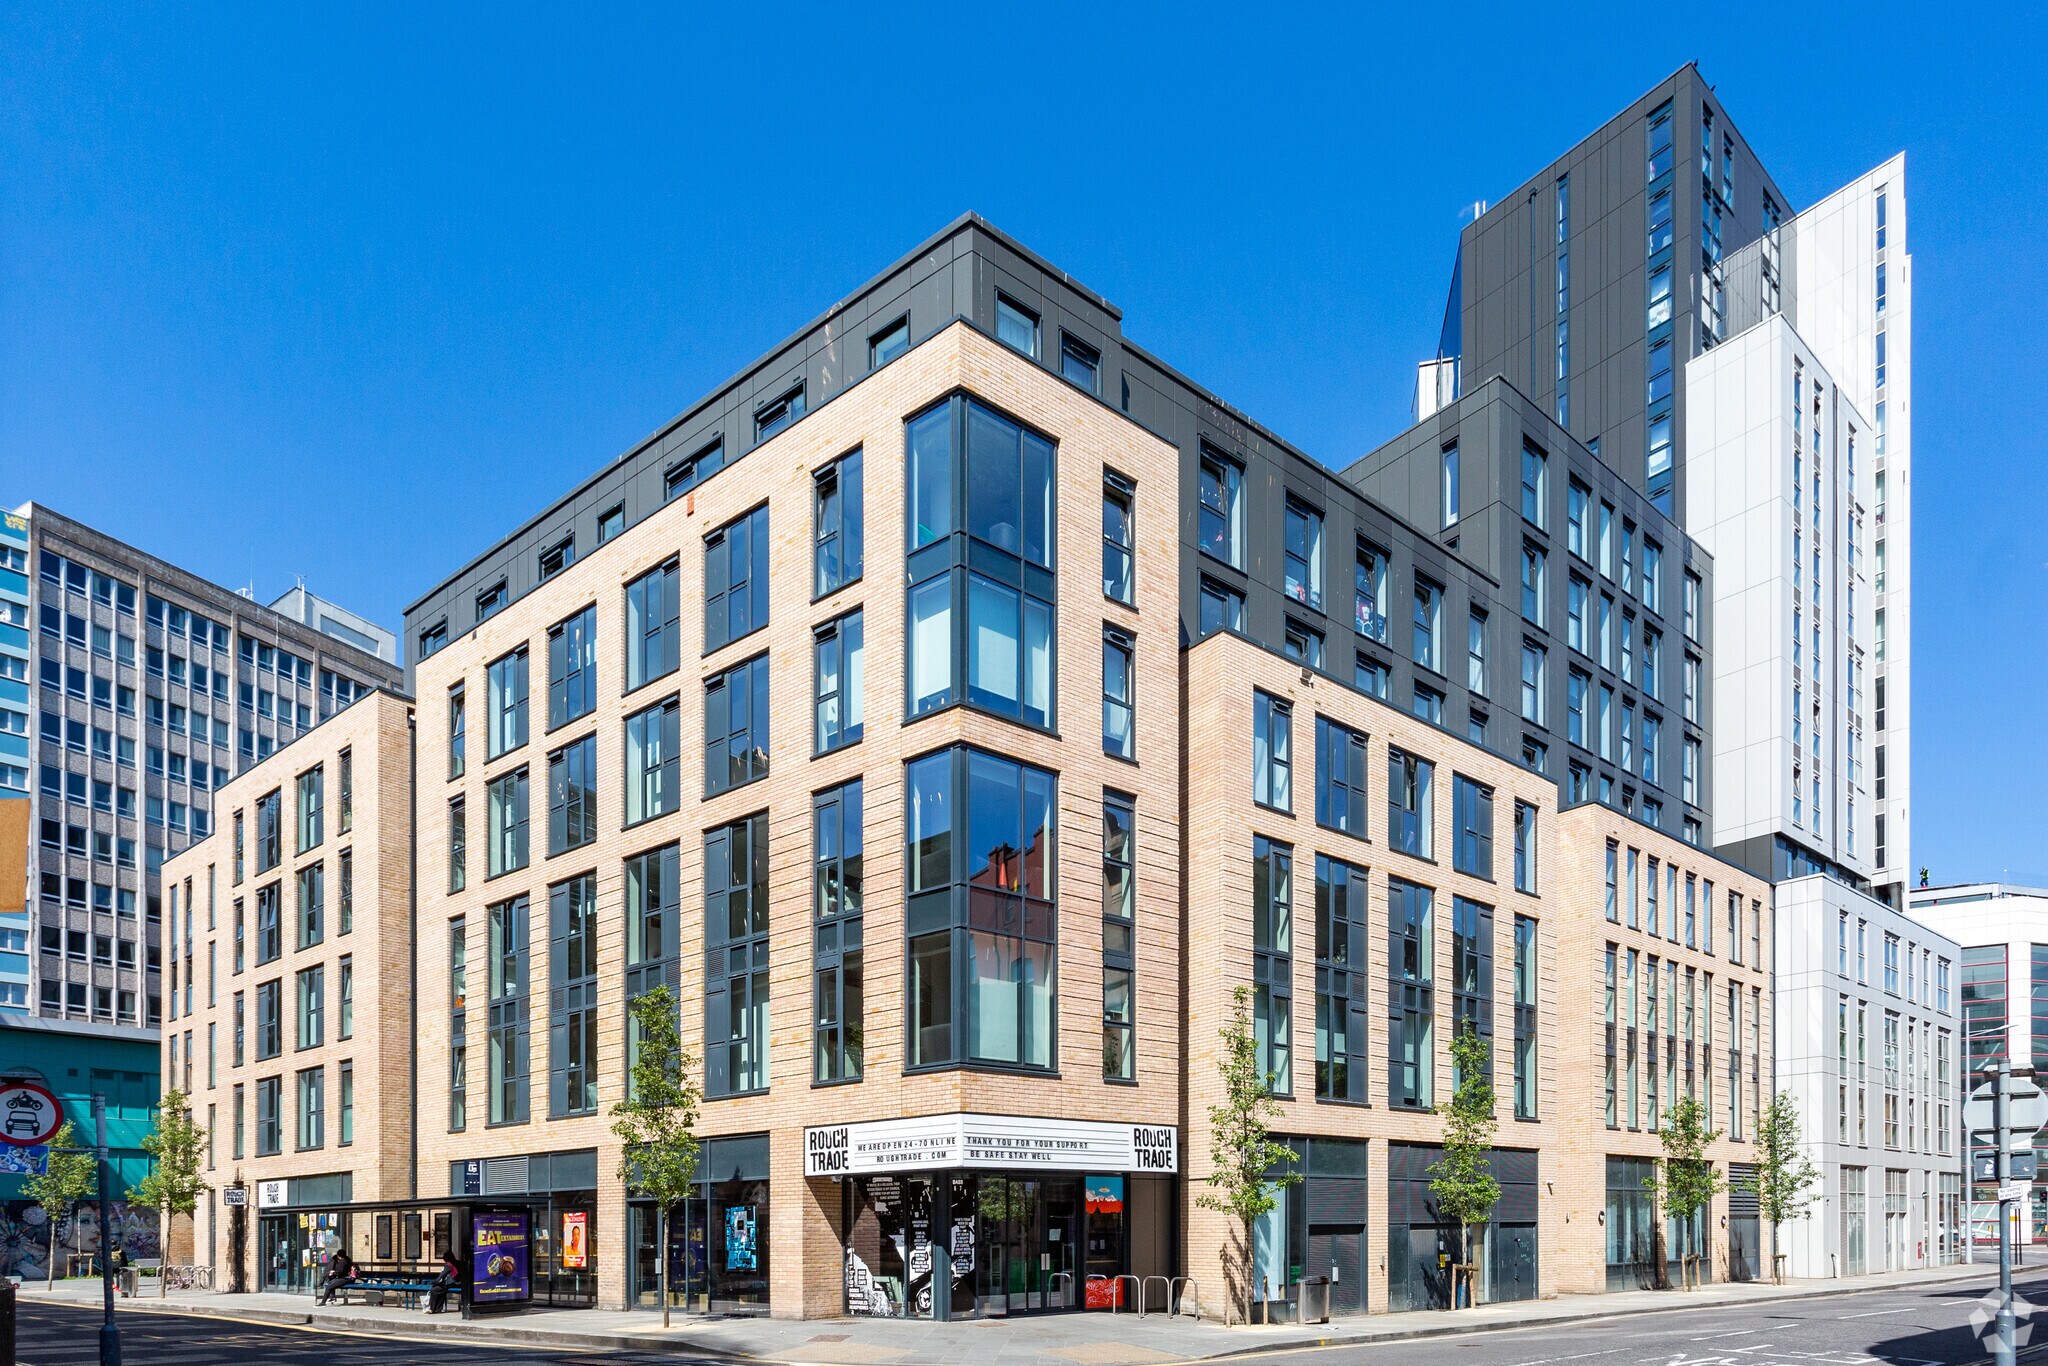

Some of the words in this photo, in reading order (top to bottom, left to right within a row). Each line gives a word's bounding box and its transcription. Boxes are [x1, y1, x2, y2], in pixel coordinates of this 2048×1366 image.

[809, 1128, 849, 1150] ROUGH
[868, 1143, 881, 1151] ARE
[967, 1136, 993, 1146] THANK
[997, 1138, 1012, 1147] YOU
[1016, 1139, 1031, 1147] FOR
[1035, 1139, 1053, 1148] YOUR
[1056, 1140, 1088, 1149] SUPPORT
[1133, 1127, 1172, 1148] ROUGH
[810, 1150, 849, 1172] TRADE
[970, 1150, 980, 1158] BE
[984, 1150, 1005, 1159] SAFE
[1008, 1151, 1028, 1160] STAY
[1031, 1152, 1052, 1160] WELL
[1134, 1148, 1173, 1169] TRADE
